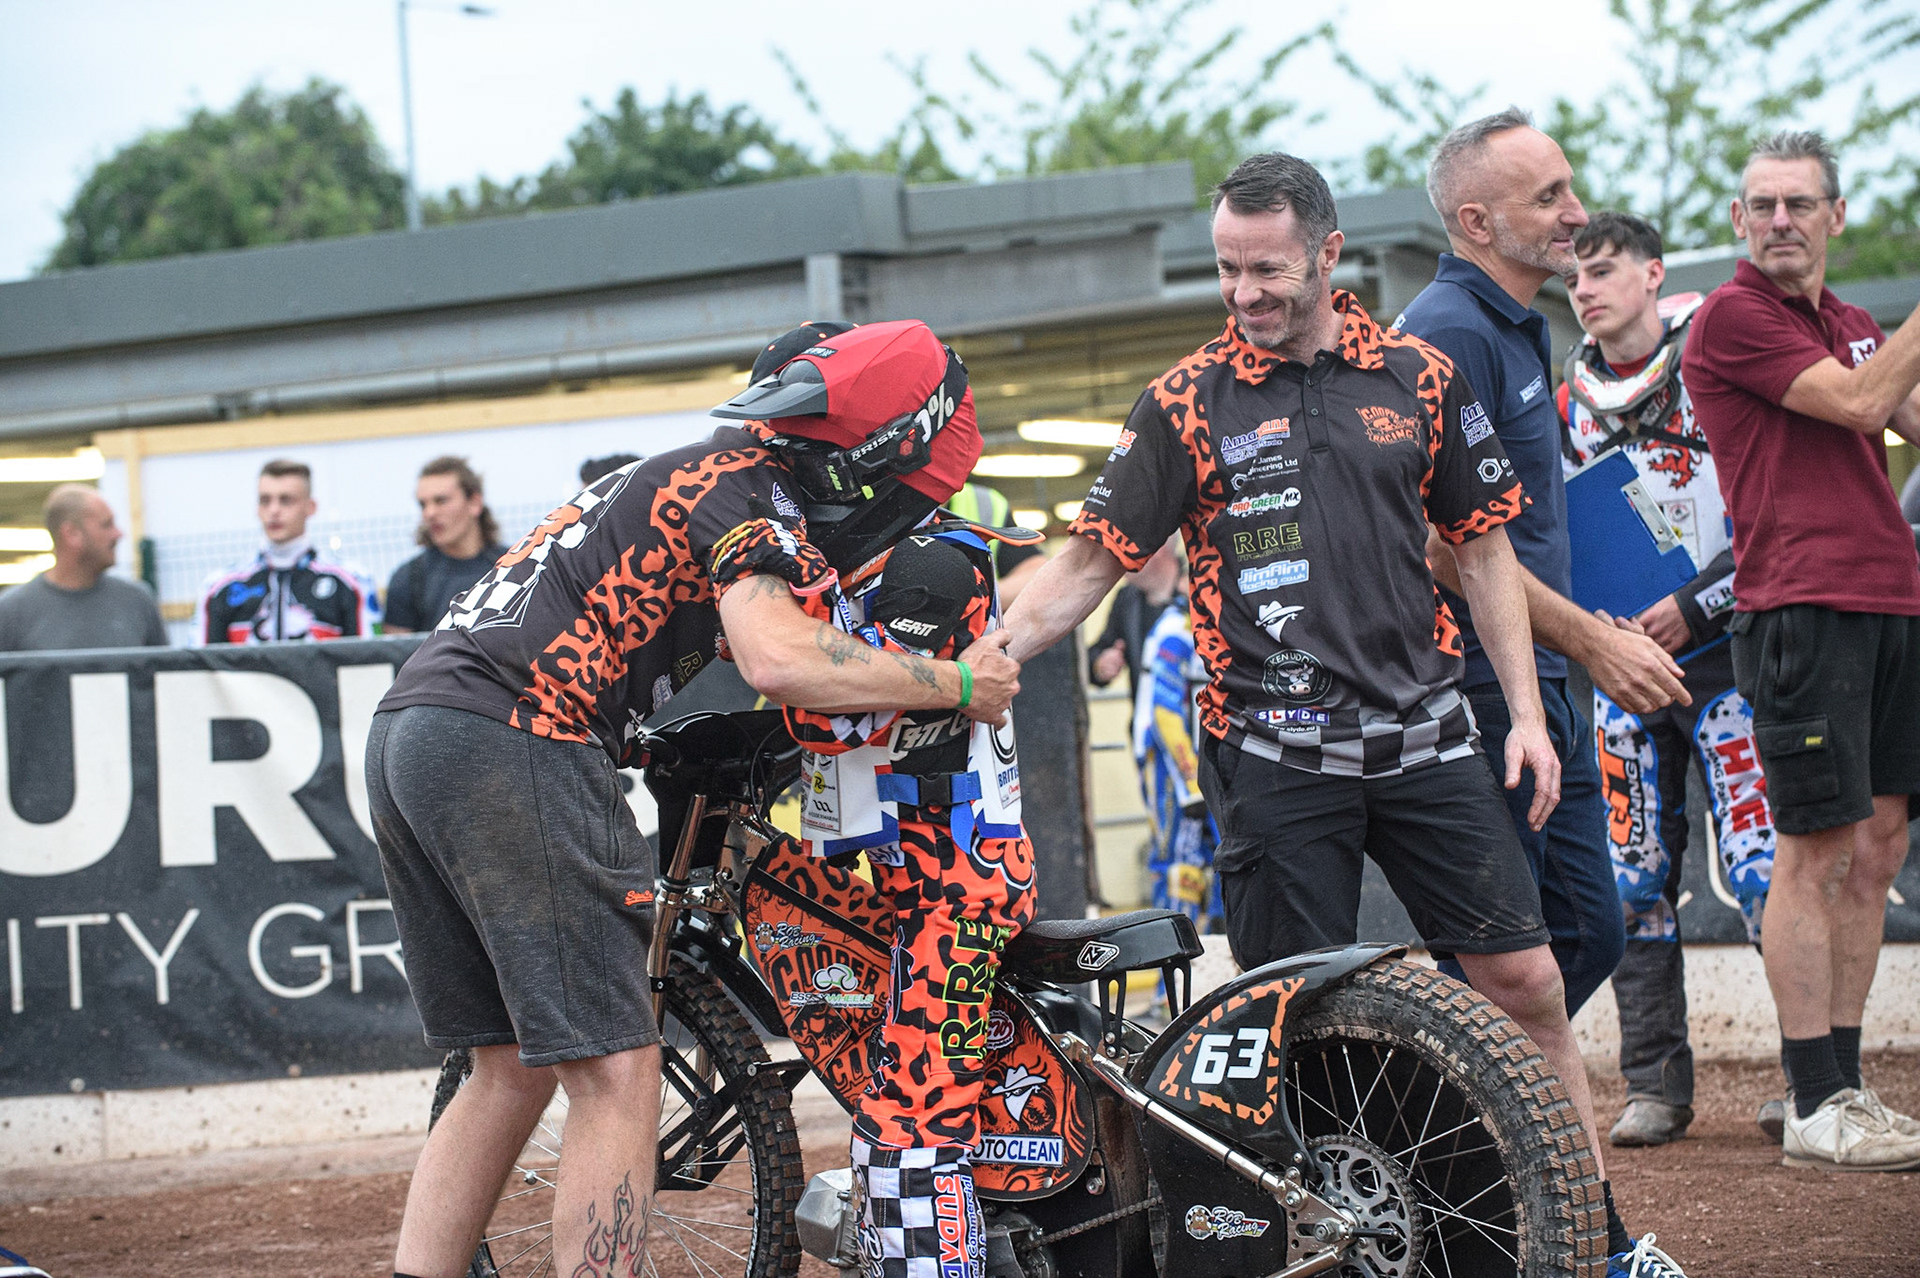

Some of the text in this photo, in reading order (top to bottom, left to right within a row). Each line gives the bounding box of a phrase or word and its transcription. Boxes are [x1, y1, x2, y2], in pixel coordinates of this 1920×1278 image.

[851, 427, 900, 461] BRISK
[1284, 458, 1298, 468] Ltd
[1232, 492, 1299, 513] PRO-GREEN MX
[1233, 522, 1301, 554] RRE
[1240, 563, 1306, 584] JimAim
[889, 617, 939, 637] LEATT
[1257, 709, 1327, 722] SLYDE
[779, 933, 816, 949] Racing
[939, 914, 1000, 1060] RRE
[1191, 1027, 1270, 1084] 63
[1413, 1029, 1470, 1075] ANLAS
[1217, 1222, 1258, 1238] Racing
